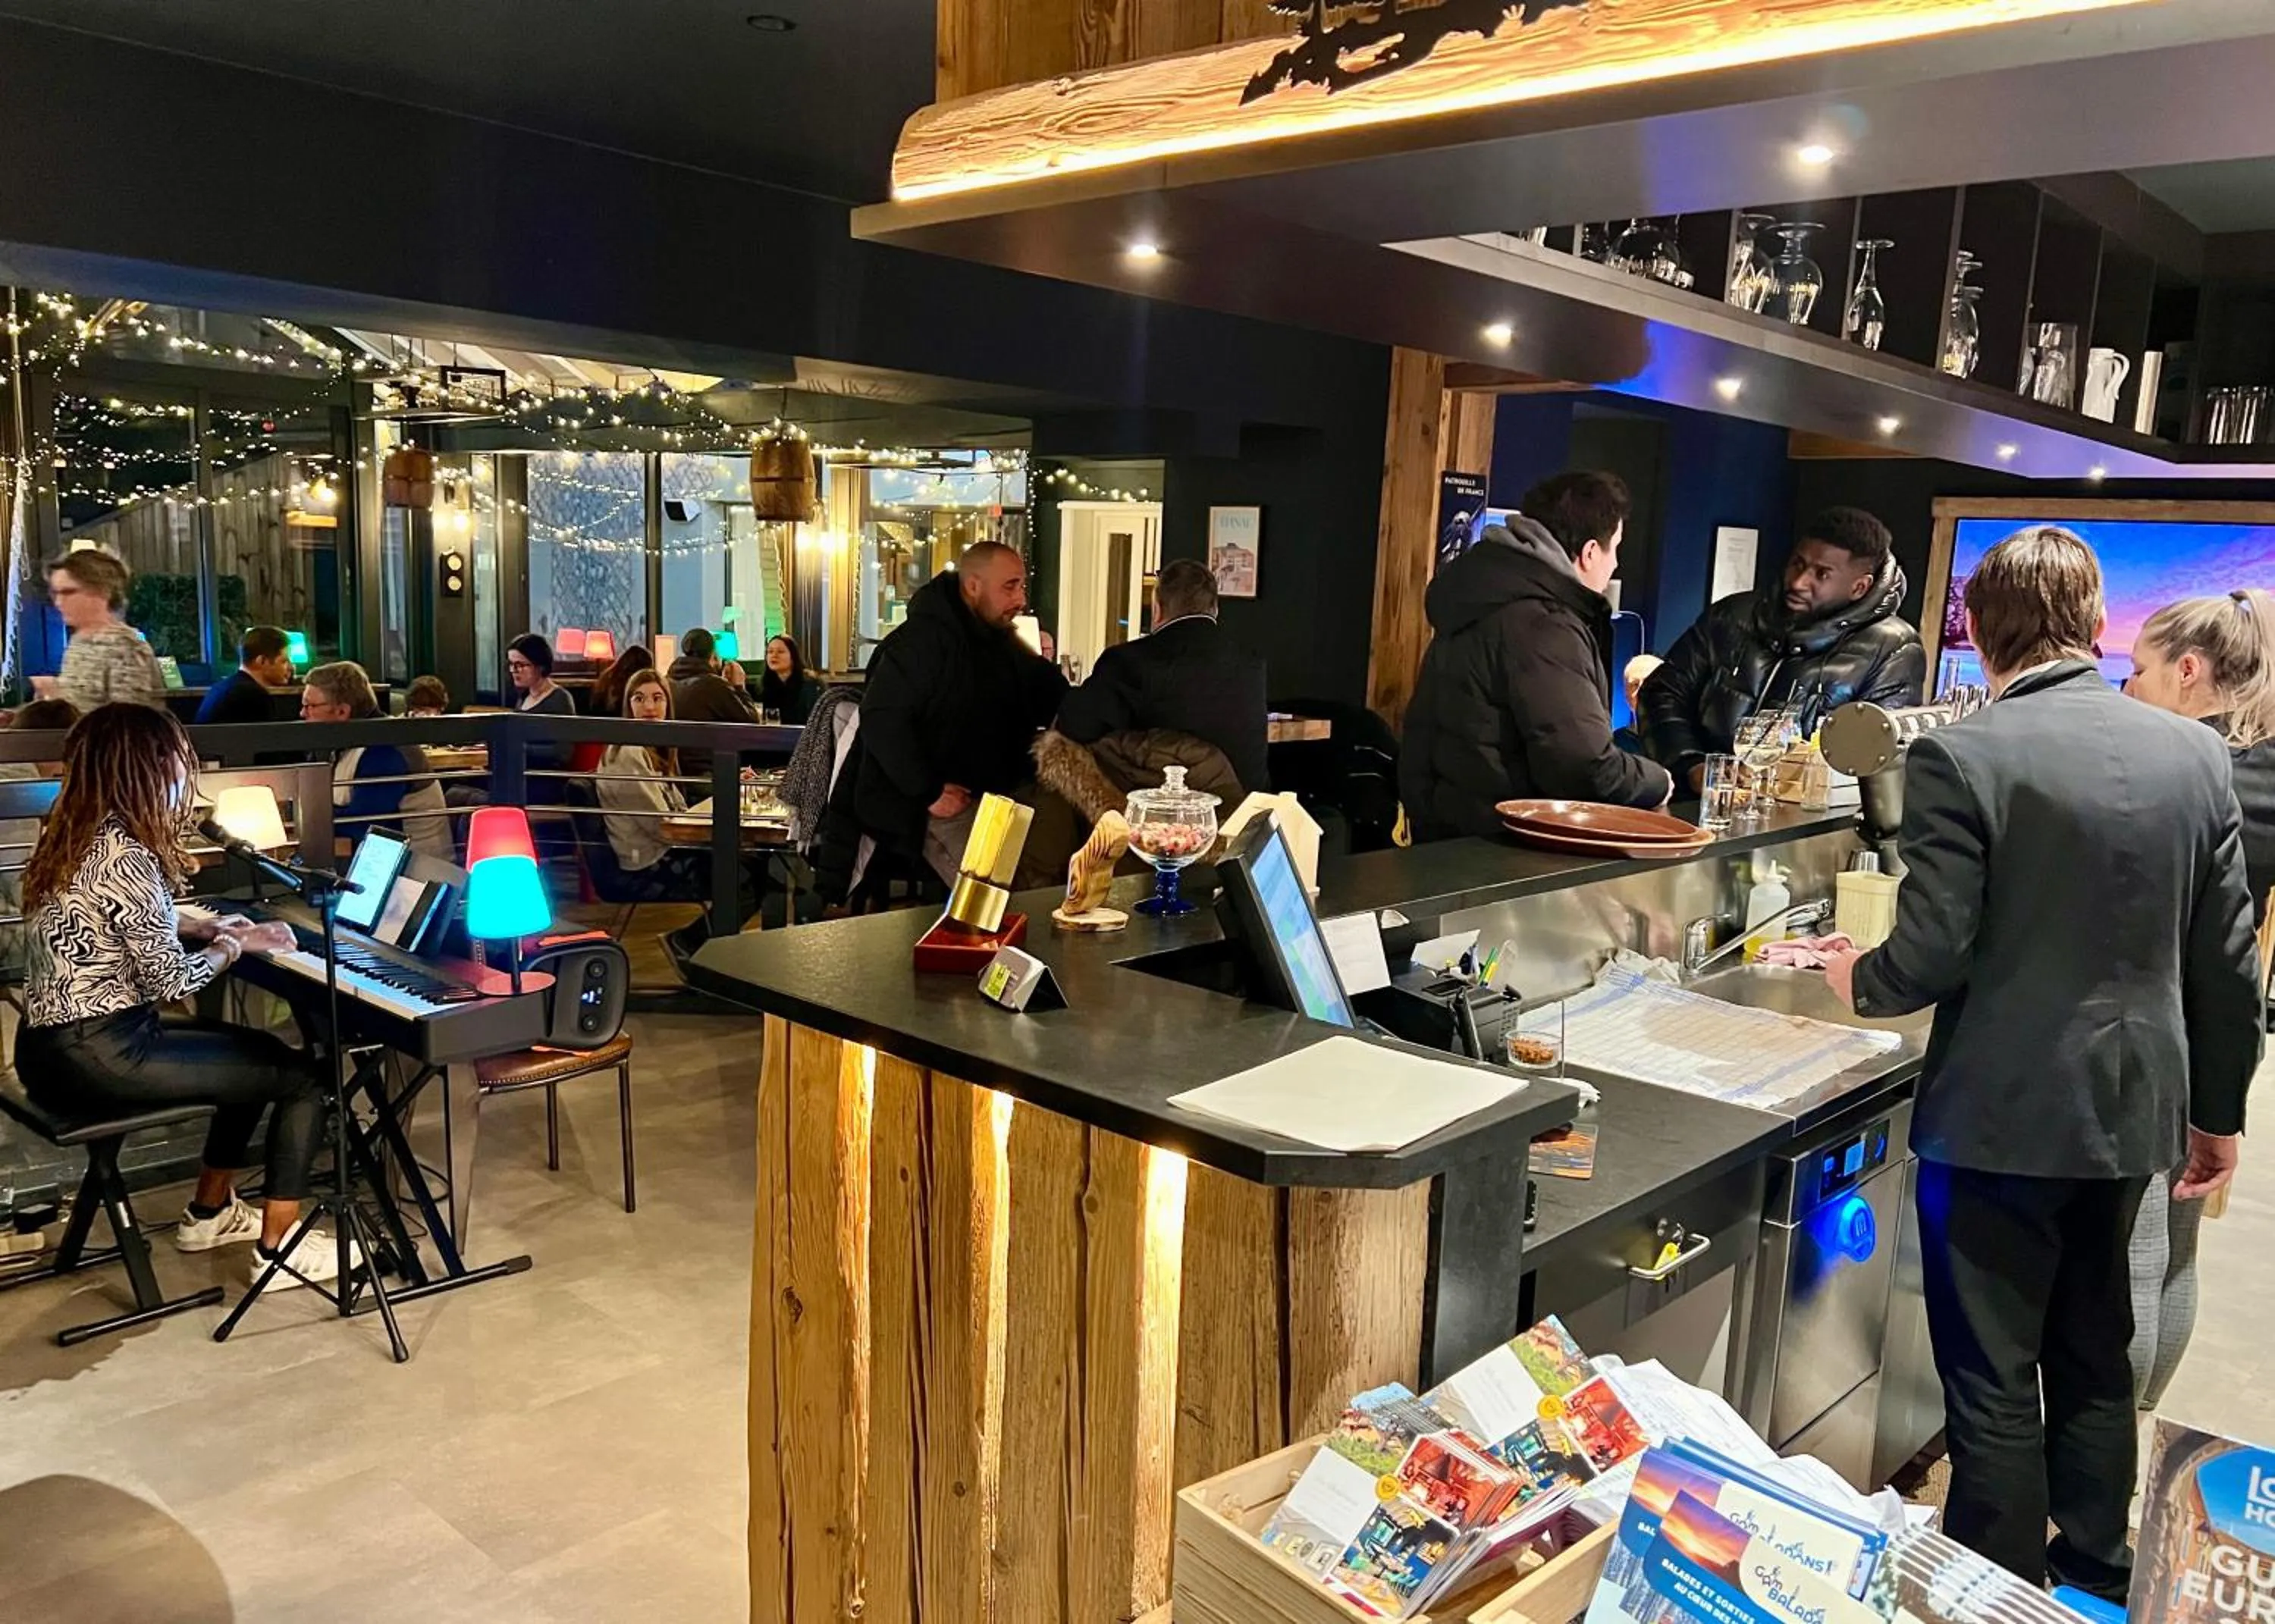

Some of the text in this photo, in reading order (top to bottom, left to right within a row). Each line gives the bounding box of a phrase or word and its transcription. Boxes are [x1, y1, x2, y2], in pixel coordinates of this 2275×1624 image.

[1662, 1557, 1756, 1624] BALADES ET SORTIES
[1674, 1582, 1688, 1594] AU
